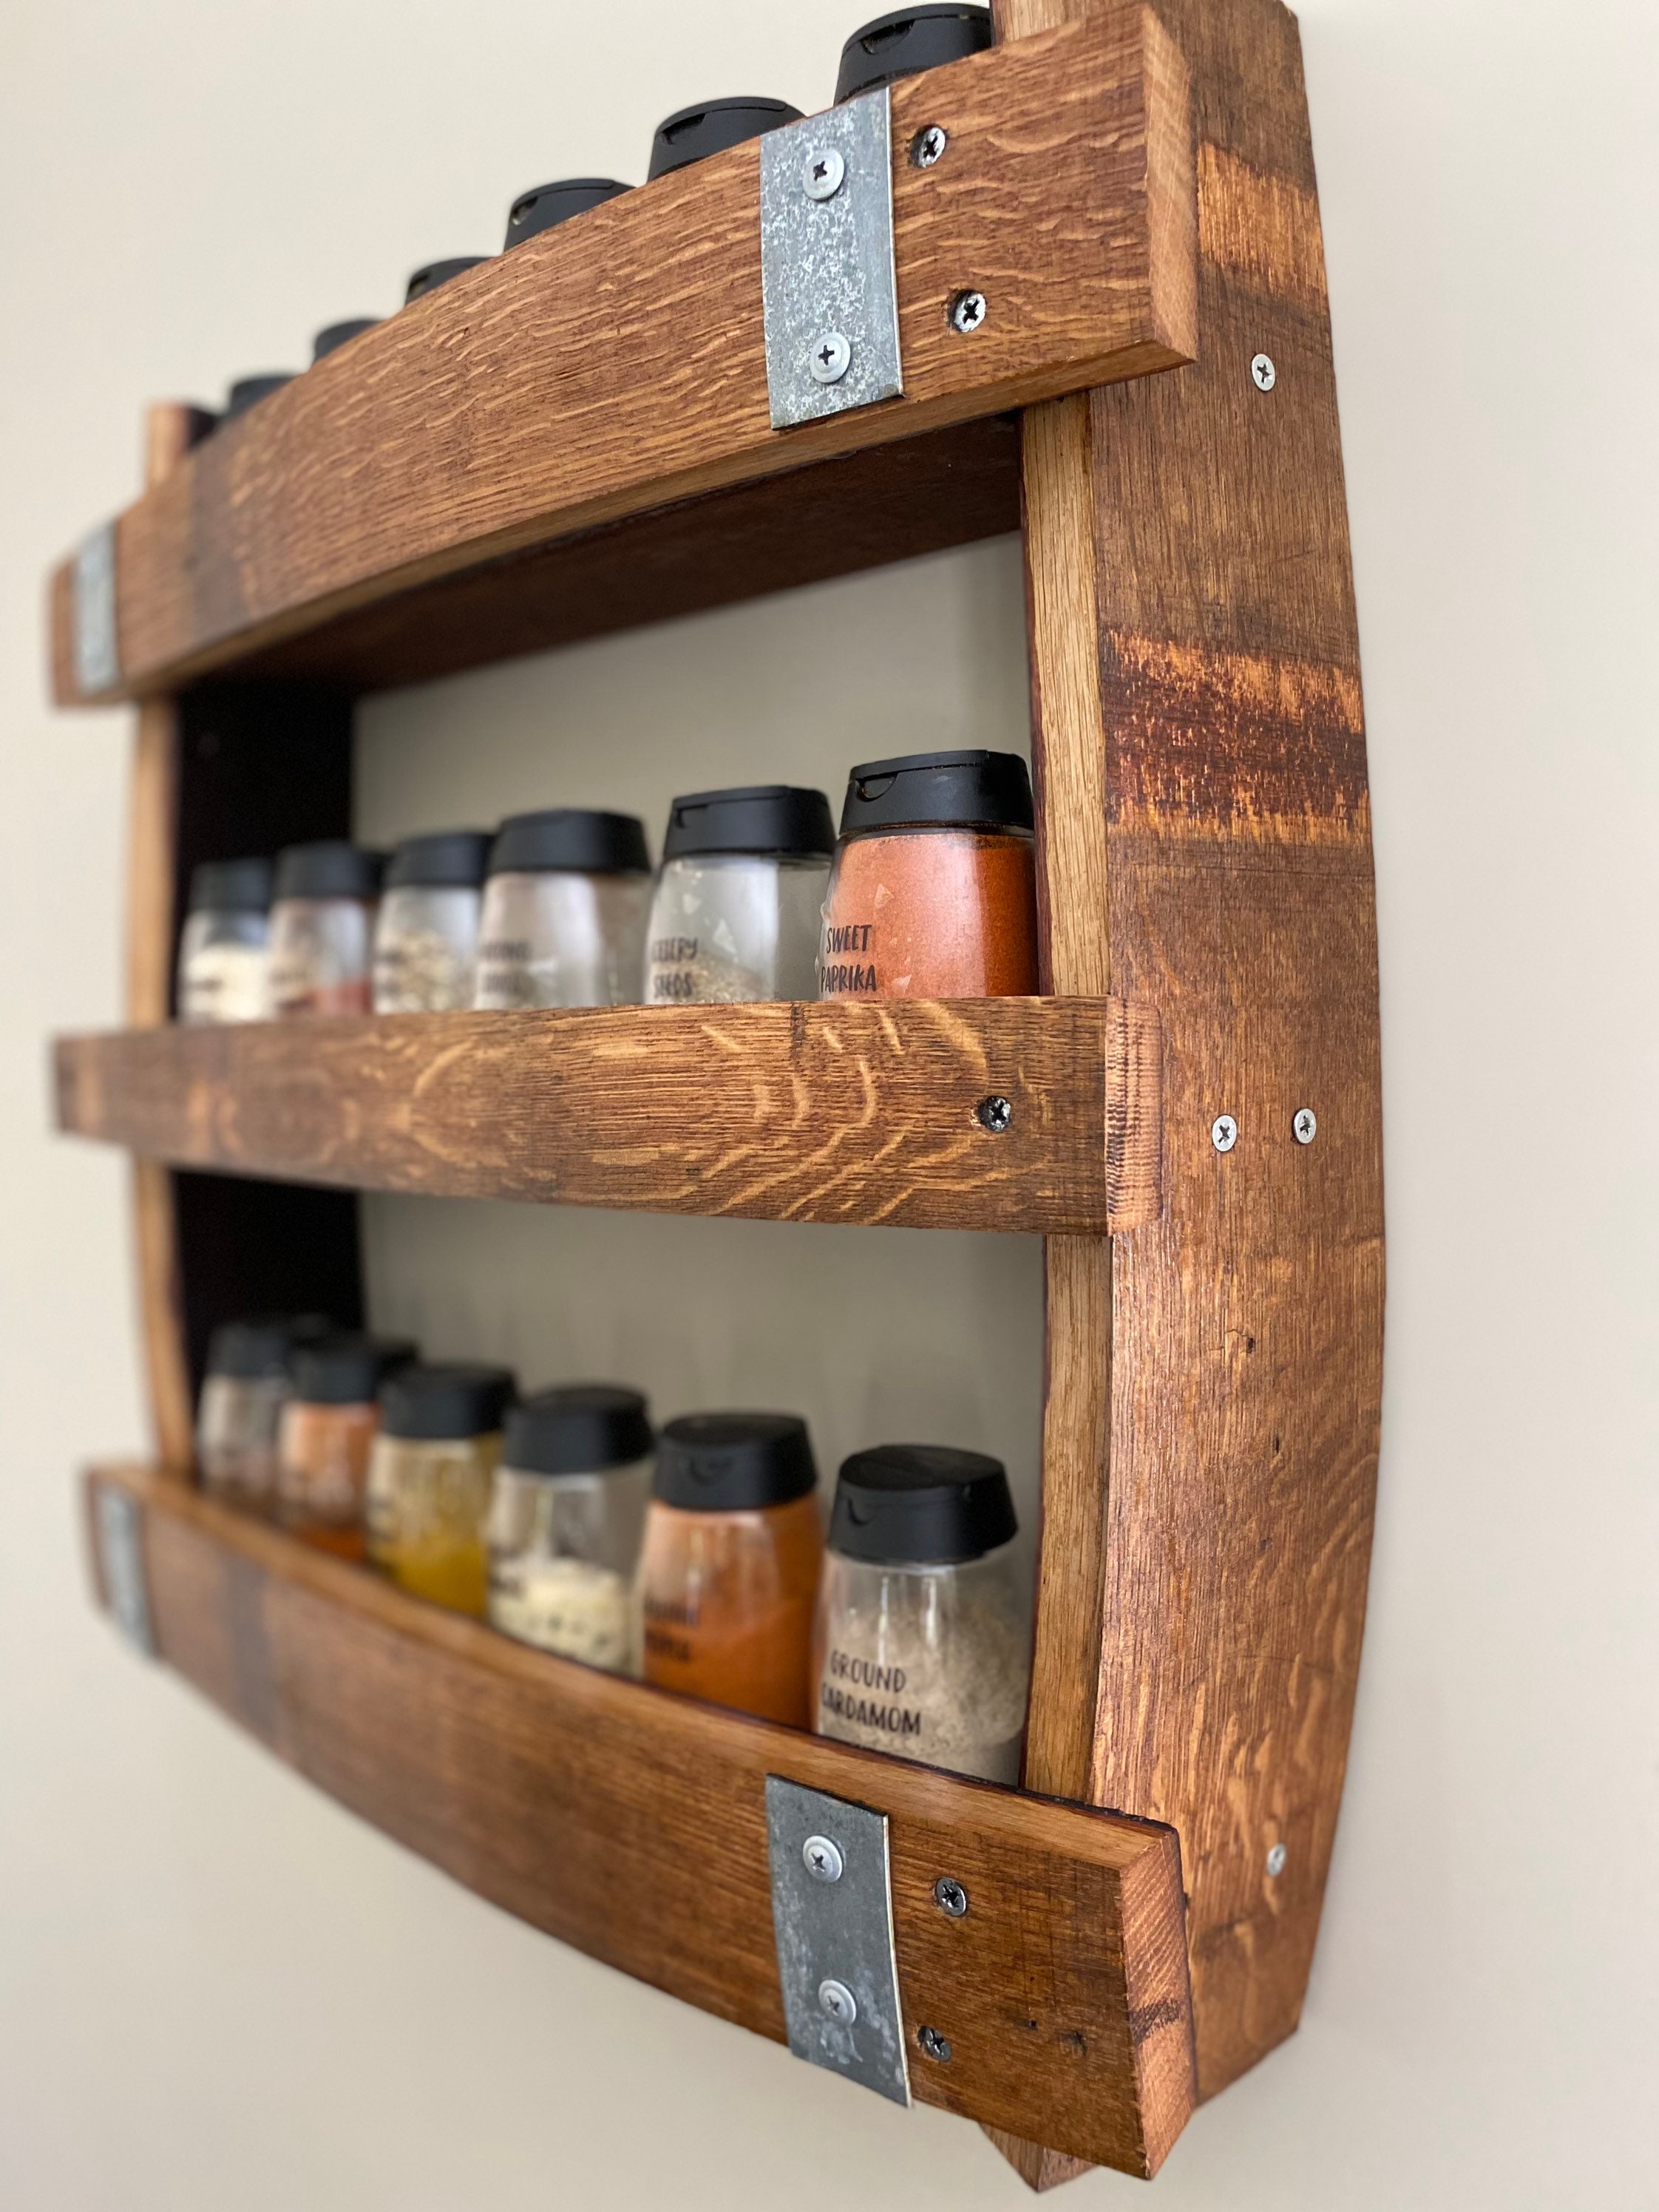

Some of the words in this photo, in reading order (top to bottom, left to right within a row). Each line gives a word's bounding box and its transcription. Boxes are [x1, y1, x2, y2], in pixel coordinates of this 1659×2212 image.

[826, 924, 872, 954] SWEET
[821, 964, 877, 993] PAPRIKA
[830, 1649, 907, 1694] GROUND
[821, 1681, 921, 1736] CARDAMOM
